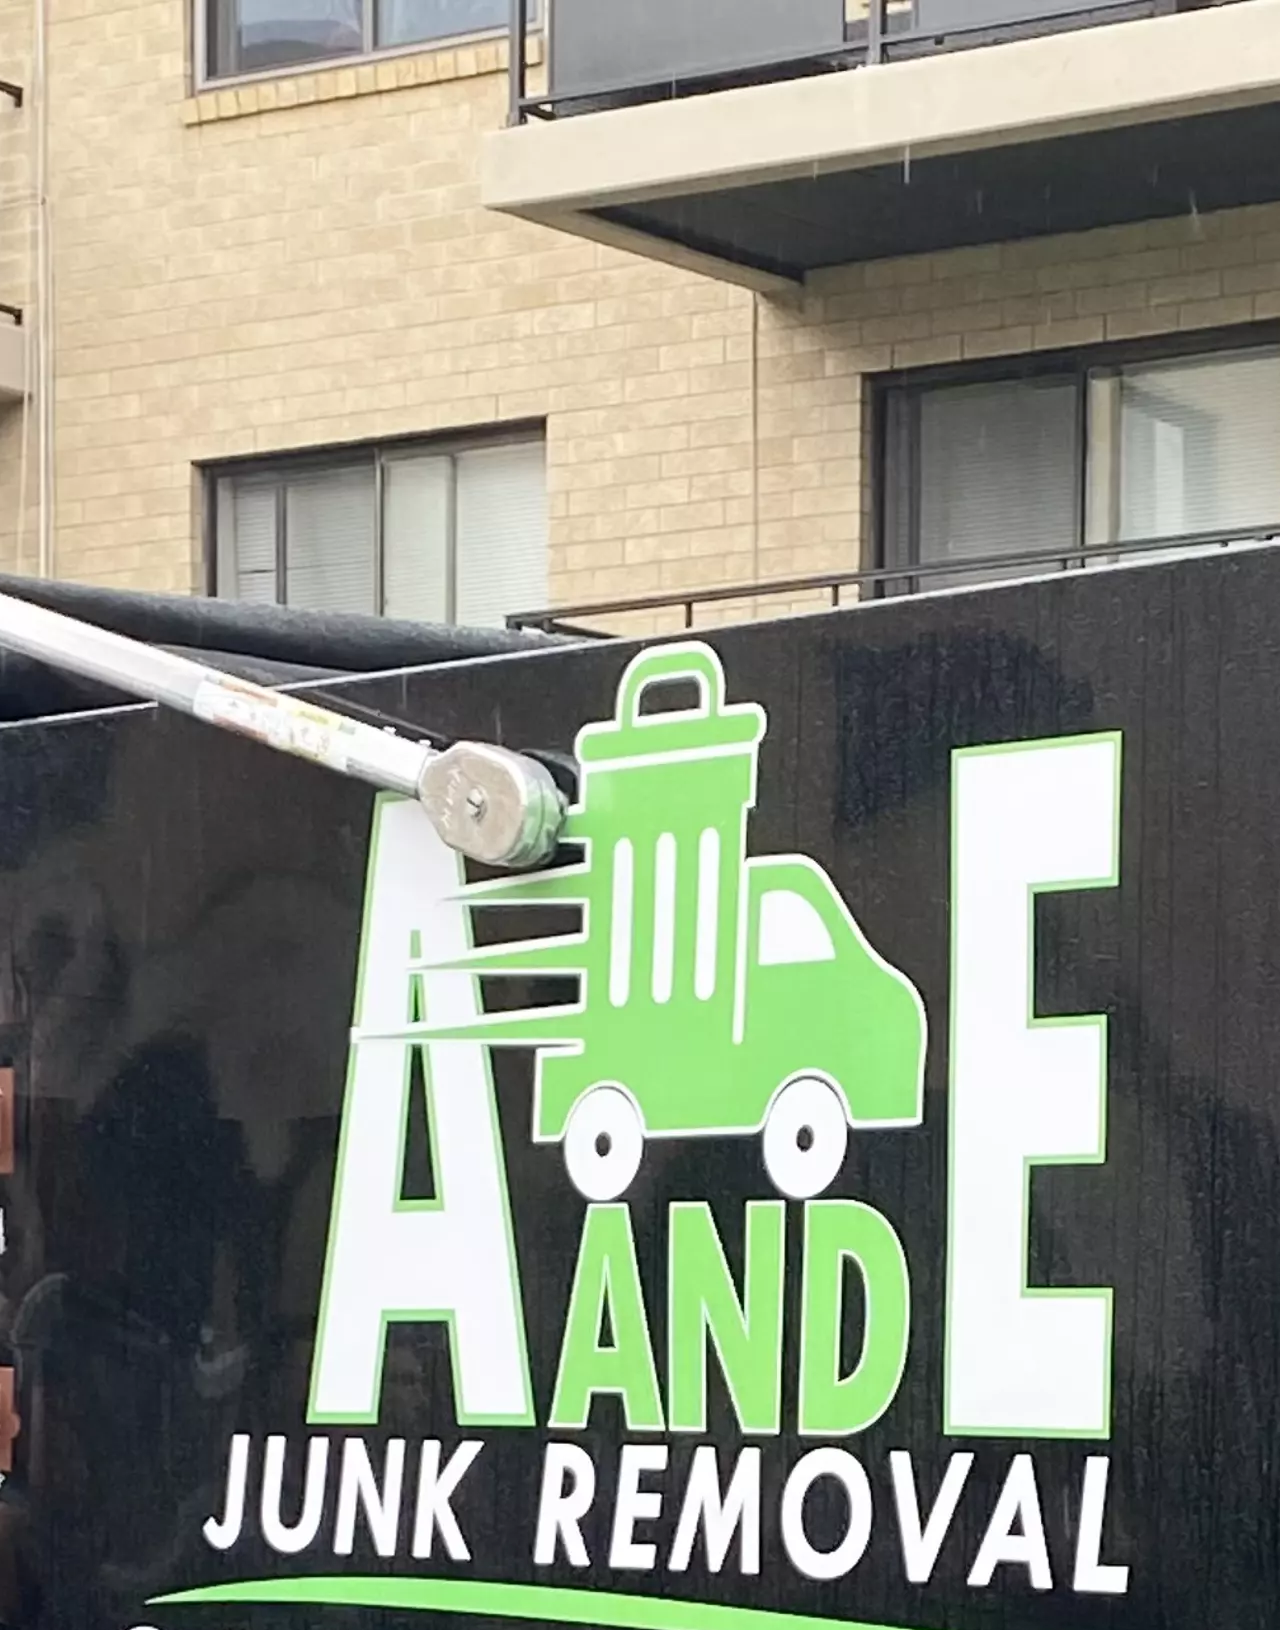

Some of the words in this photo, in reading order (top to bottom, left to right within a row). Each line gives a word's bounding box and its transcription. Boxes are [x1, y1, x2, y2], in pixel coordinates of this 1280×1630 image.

[305, 790, 536, 1428] A
[547, 1200, 910, 1438] AND
[943, 730, 1123, 1440] E
[202, 1434, 485, 1561] JUNK
[533, 1442, 1129, 1594] REMOVAL
